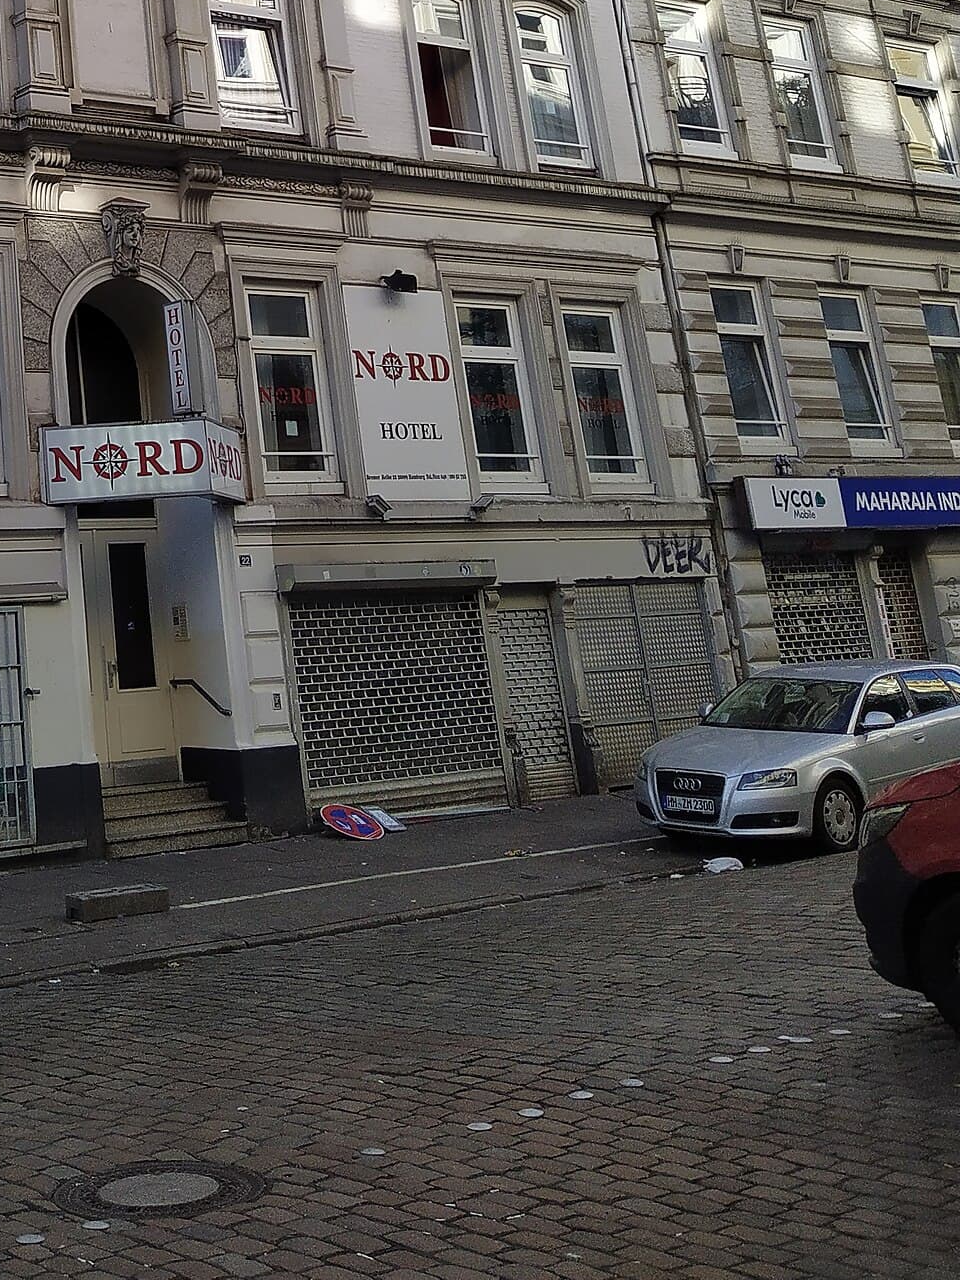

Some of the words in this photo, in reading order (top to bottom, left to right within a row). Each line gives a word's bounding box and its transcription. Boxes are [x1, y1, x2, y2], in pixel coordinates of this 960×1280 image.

[167, 307, 187, 409] HOTEL
[352, 349, 450, 383] NORD
[380, 422, 442, 440] HOTEL
[49, 437, 204, 484] NORD
[208, 437, 242, 481] NORD
[771, 485, 814, 512] Lyca
[855, 491, 937, 512] MAHARAJA
[938, 492, 960, 512] IND
[793, 510, 816, 520] Mobile
